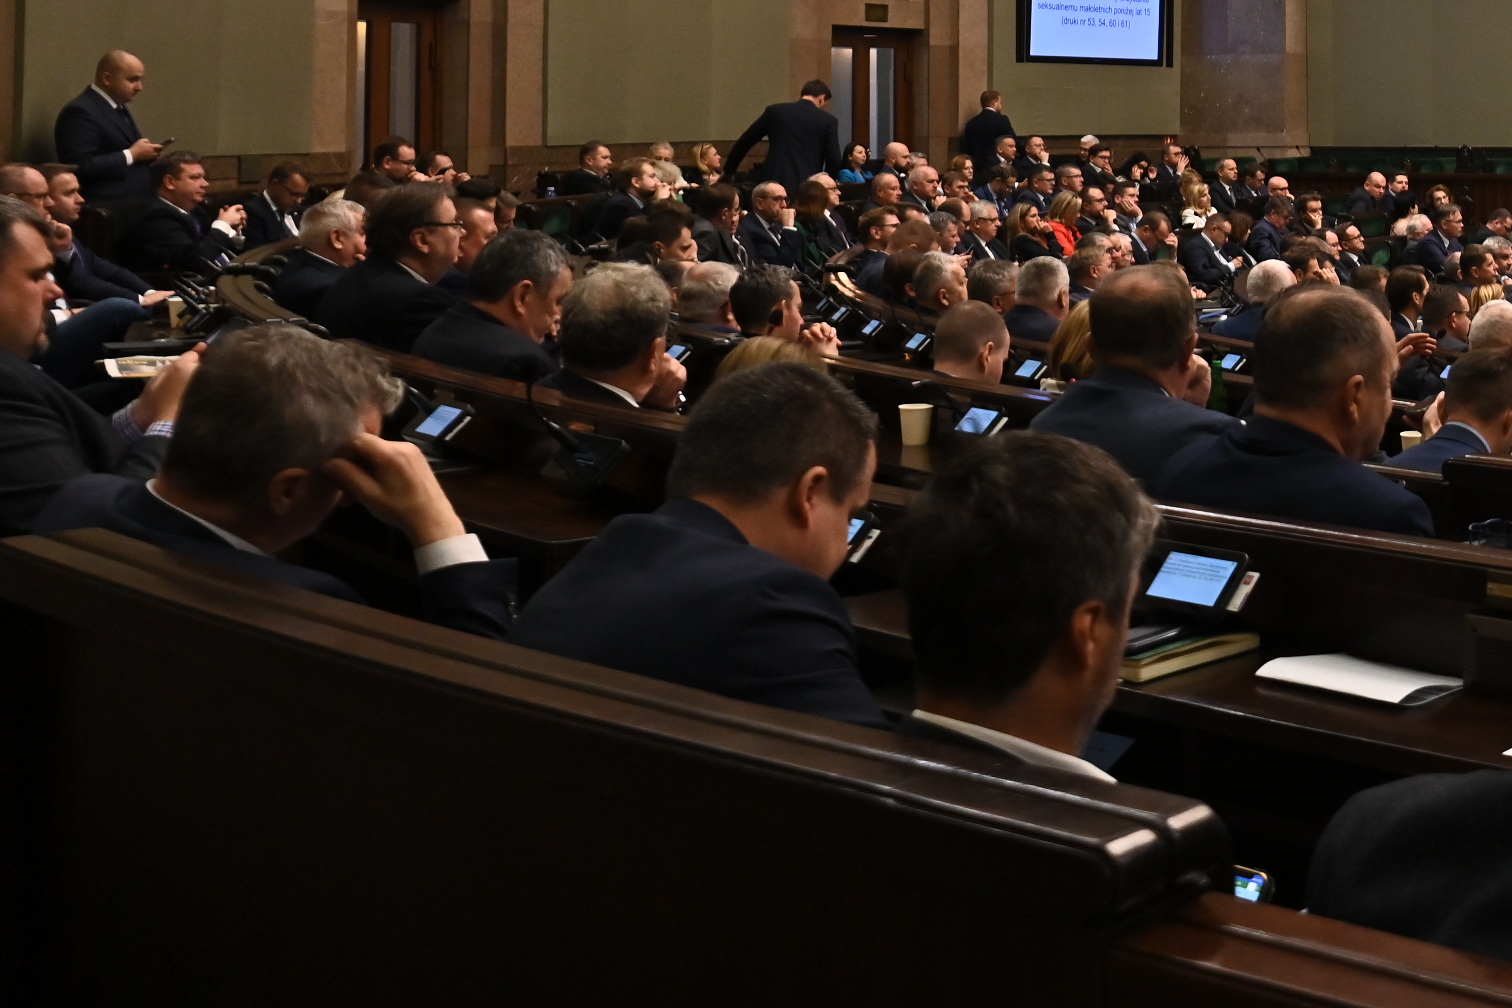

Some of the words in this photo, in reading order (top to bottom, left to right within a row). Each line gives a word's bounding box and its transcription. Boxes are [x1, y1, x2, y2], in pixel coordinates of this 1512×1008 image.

[1038, 2, 1078, 11] seksualnemu
[1080, 4, 1112, 14] małoletnich
[1114, 7, 1134, 16] poniżej
[1088, 18, 1096, 27] 53,
[1099, 19, 1107, 27] 54,
[1121, 20, 1130, 29] 61)
